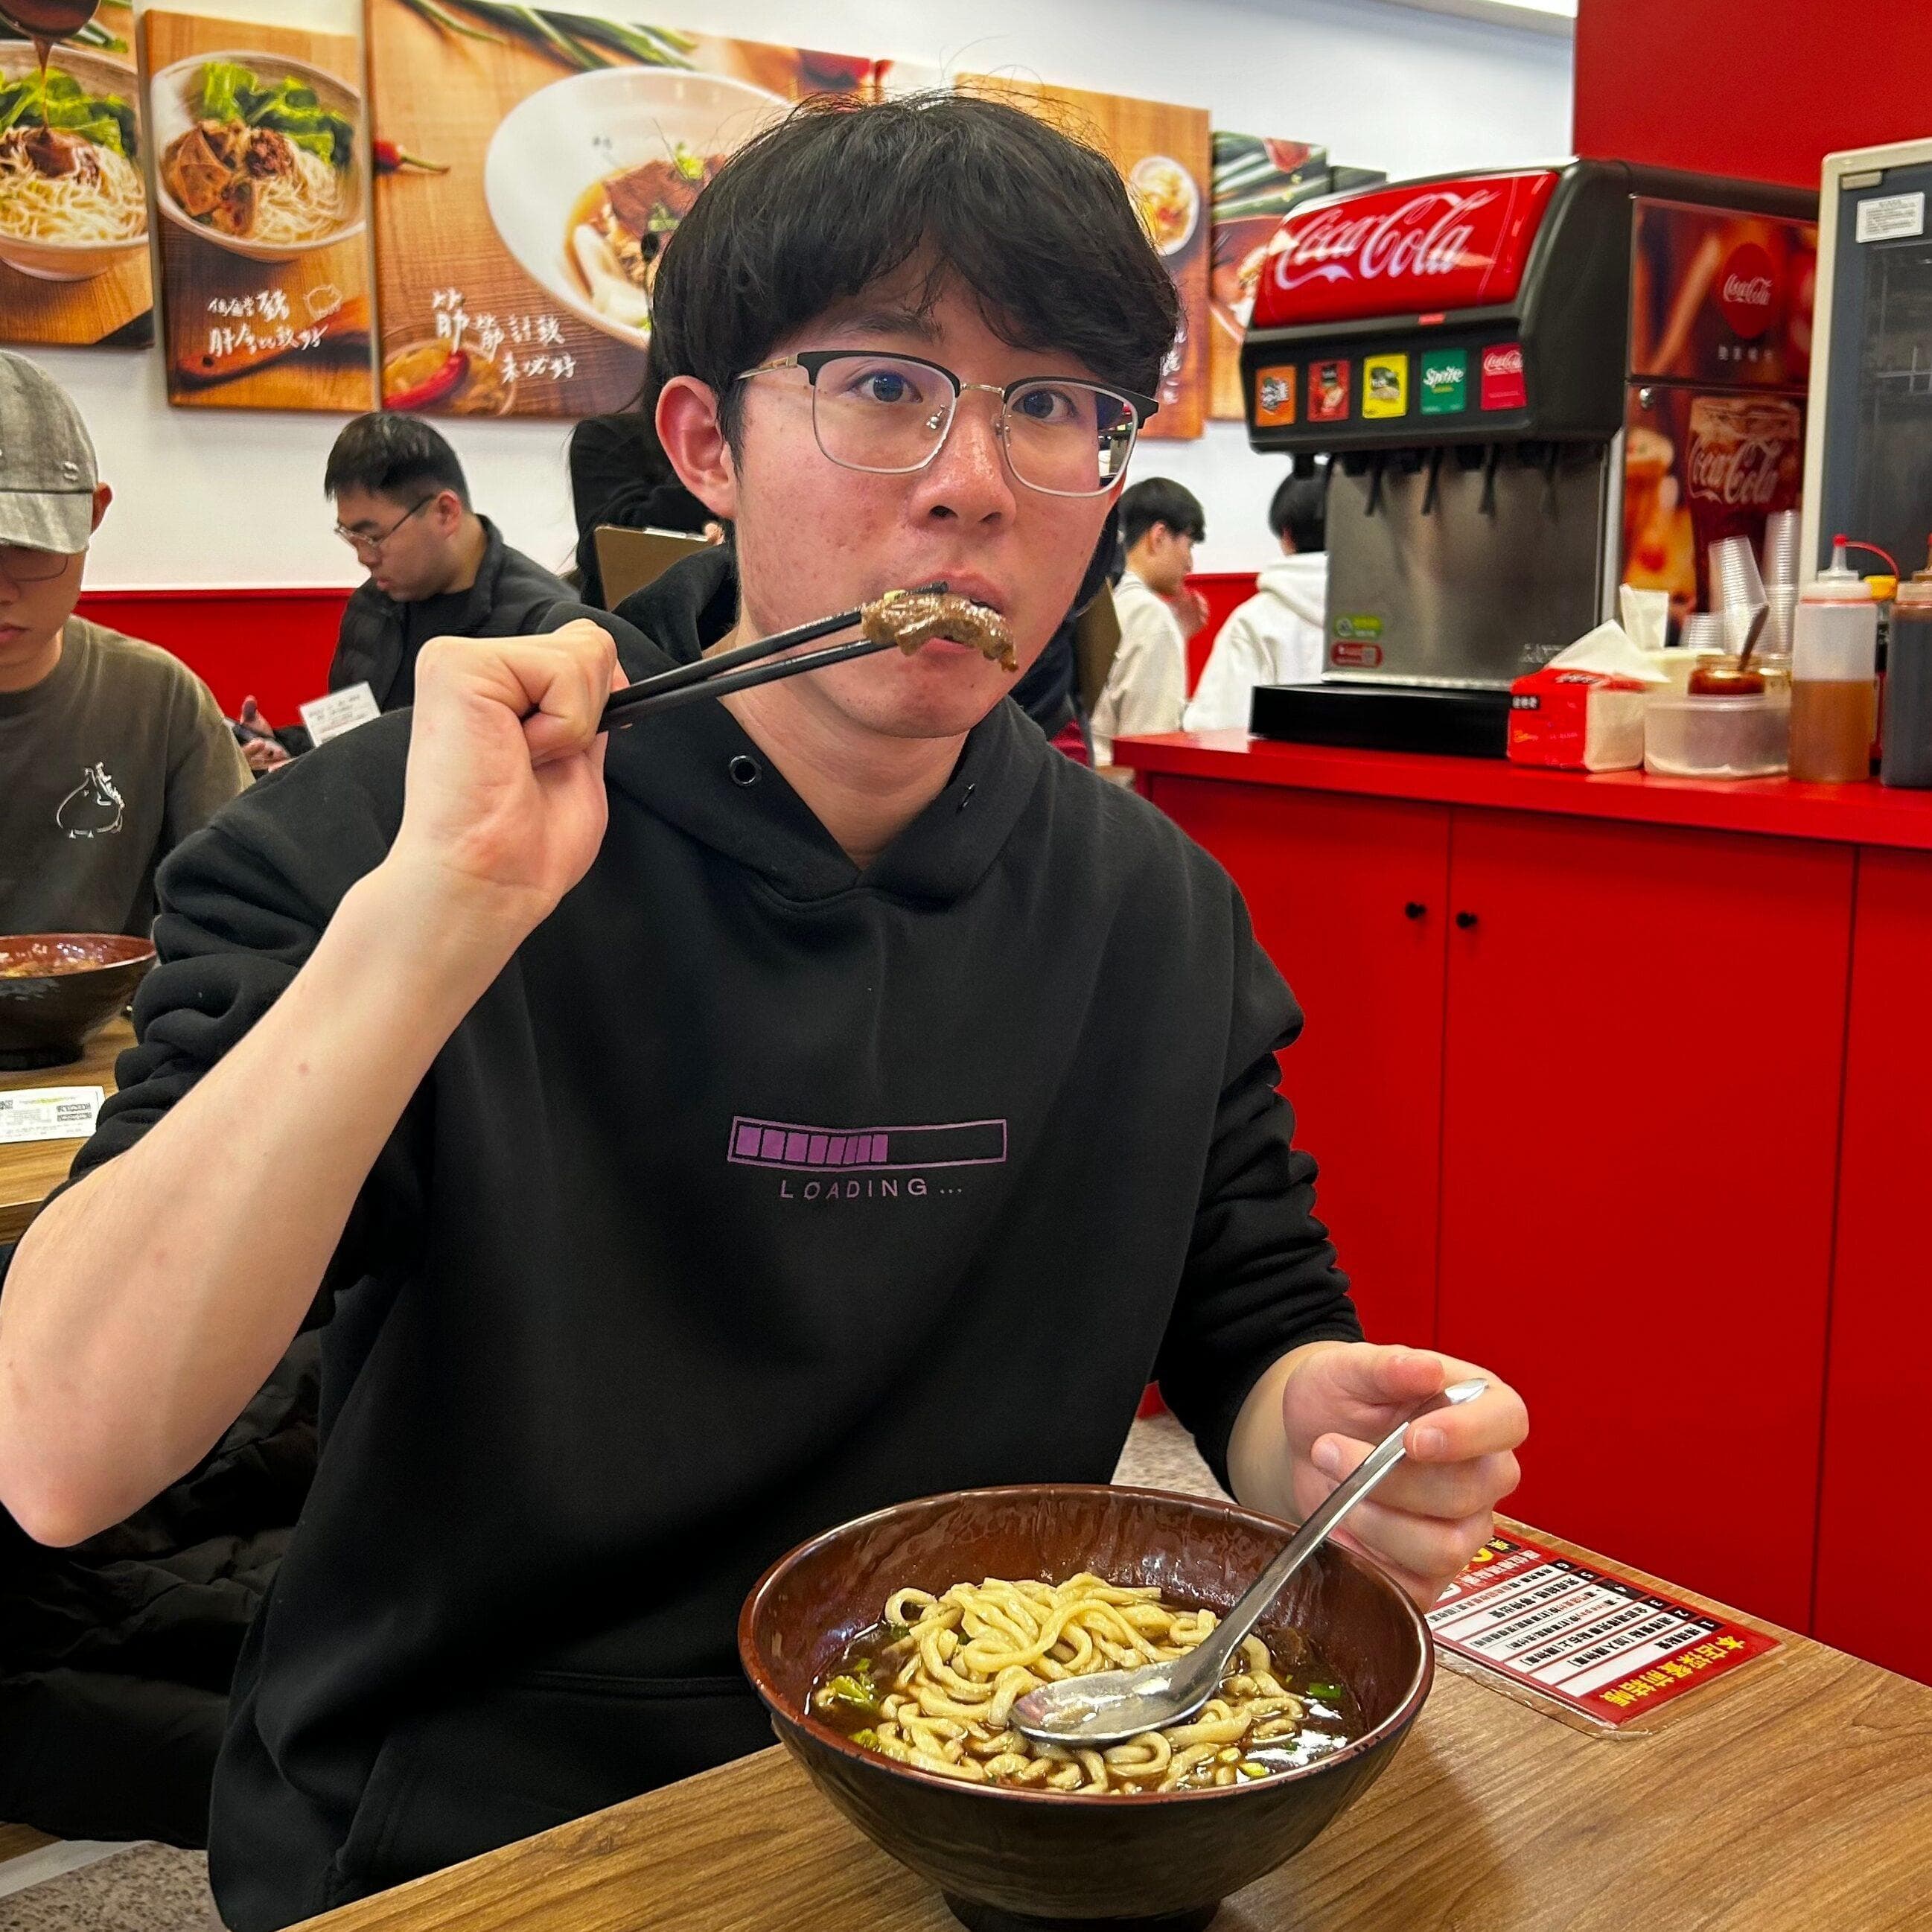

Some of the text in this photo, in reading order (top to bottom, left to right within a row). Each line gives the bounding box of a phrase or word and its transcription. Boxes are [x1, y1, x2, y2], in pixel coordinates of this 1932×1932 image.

[1423, 366, 1464, 389] Sprite
[1599, 1635, 1746, 1707] 本店採餐前結帳
